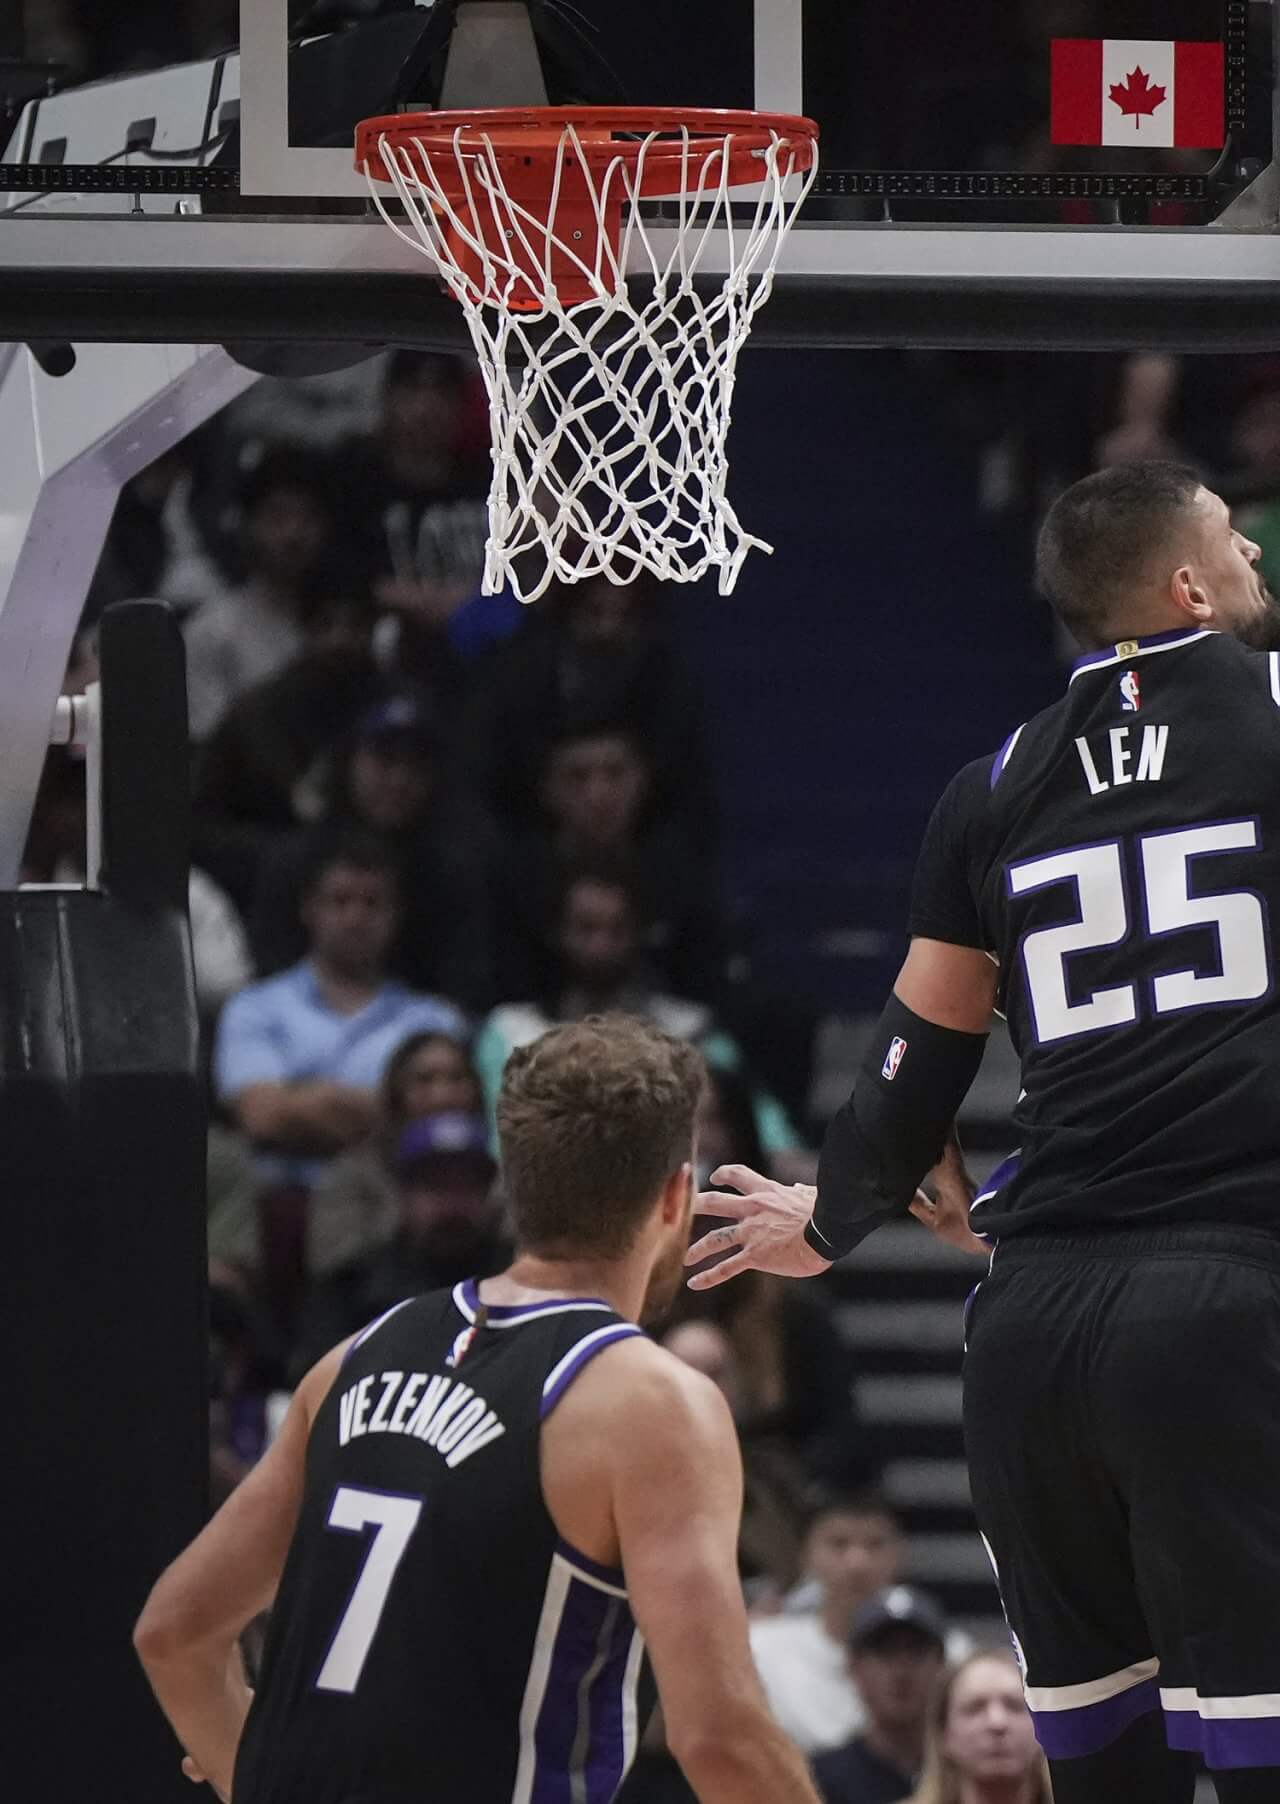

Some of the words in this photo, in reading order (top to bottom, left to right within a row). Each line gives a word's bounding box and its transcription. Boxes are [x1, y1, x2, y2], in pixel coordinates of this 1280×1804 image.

[1074, 724, 1170, 795] LEN
[1007, 818, 1270, 1045] 25
[338, 1371, 506, 1469] VEZENKOV
[315, 1485, 424, 1694] 7
